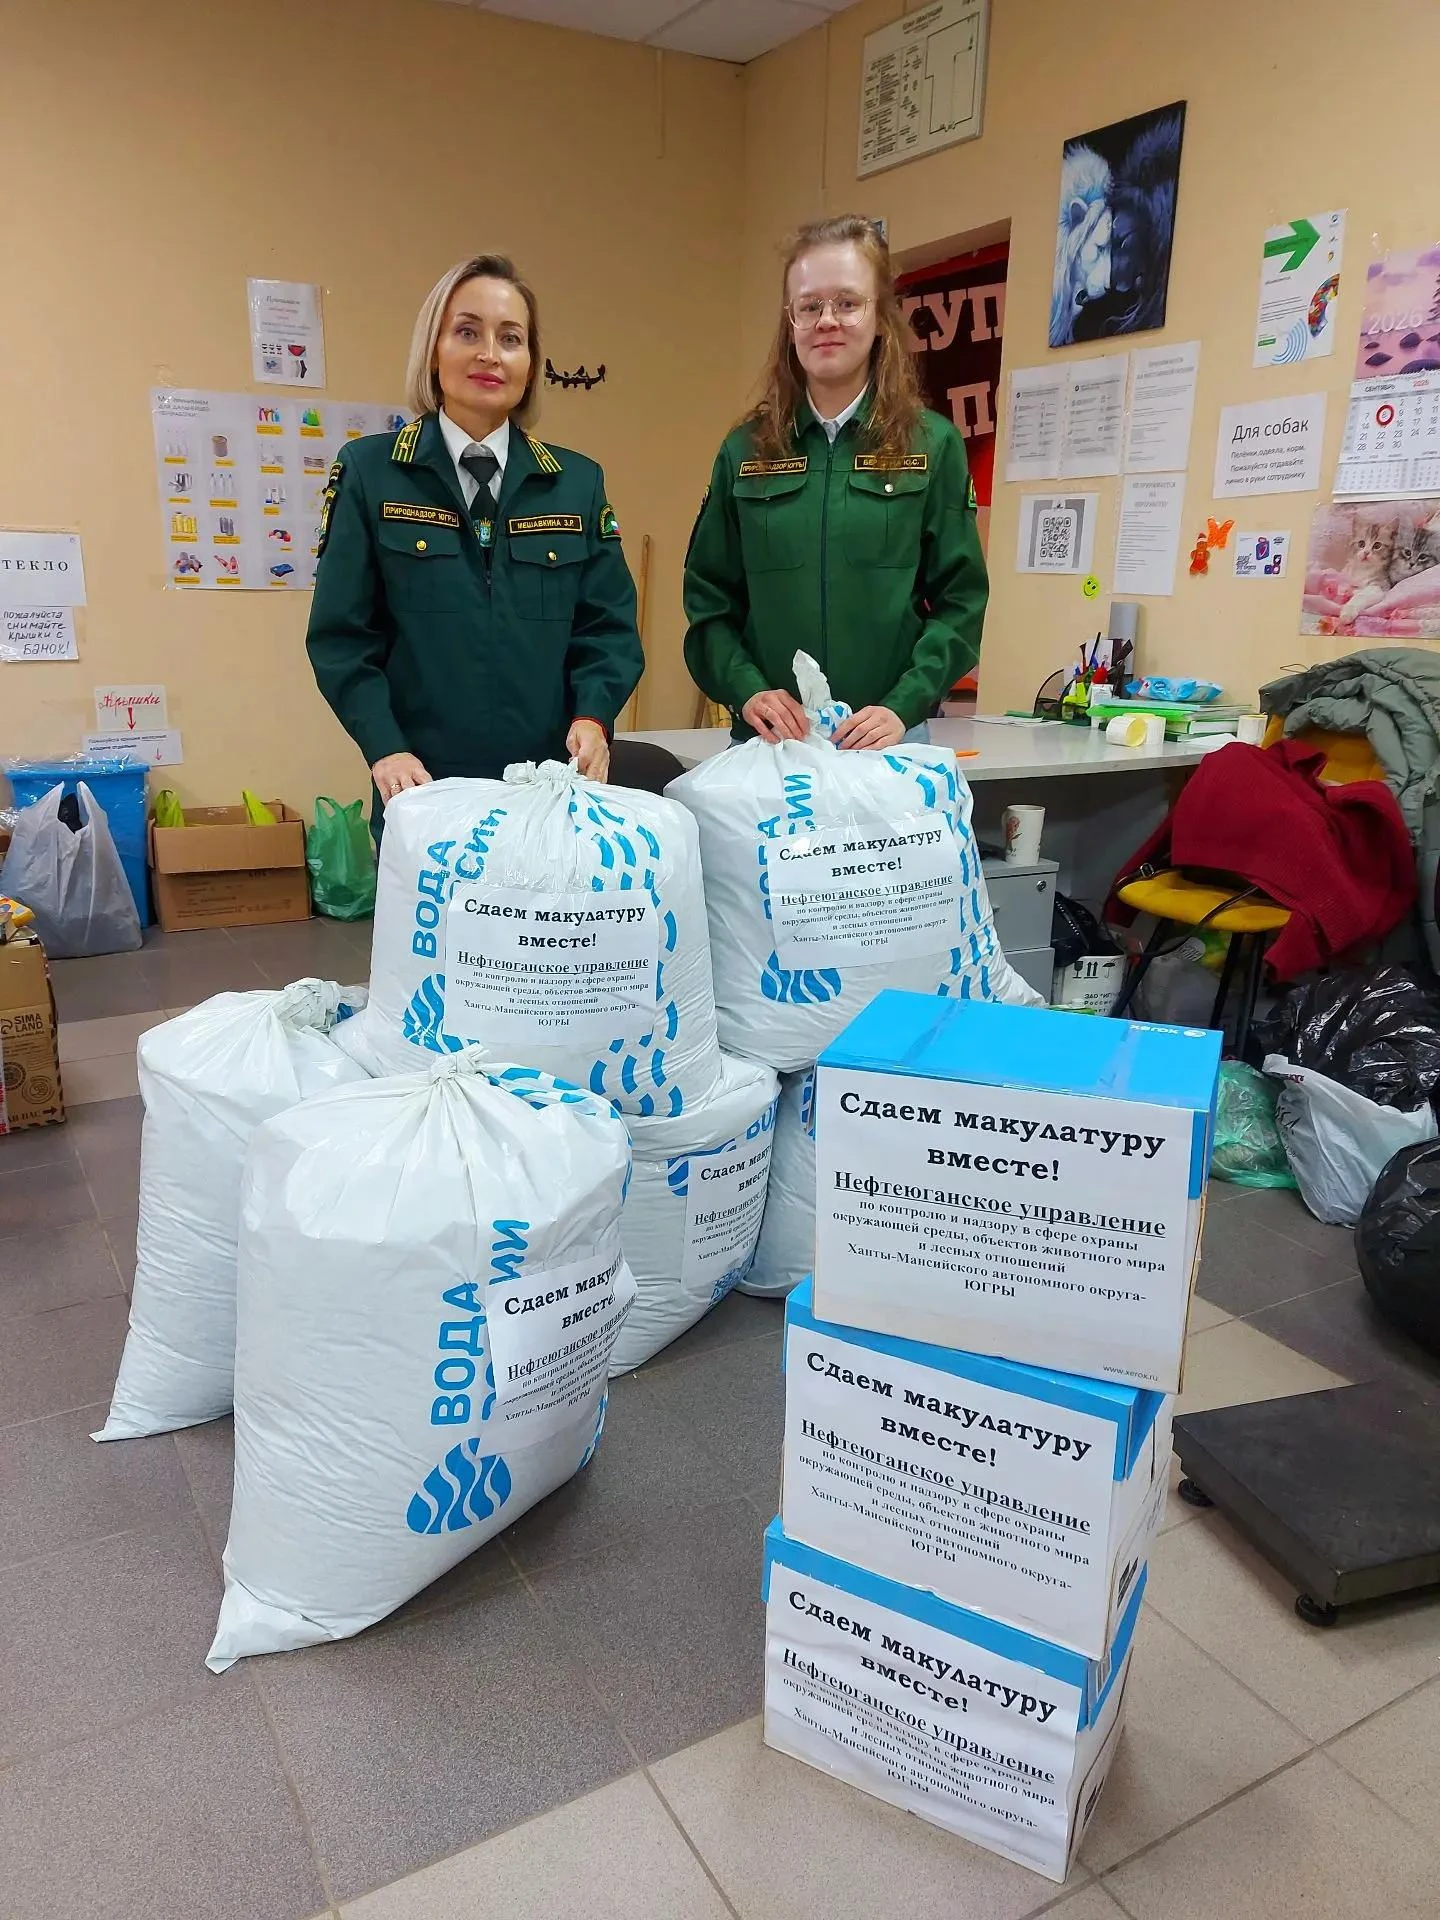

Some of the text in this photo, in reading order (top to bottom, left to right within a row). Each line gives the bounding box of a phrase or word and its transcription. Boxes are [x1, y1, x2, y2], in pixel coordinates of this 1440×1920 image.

[1231, 417, 1309, 444] Для собак
[1376, 431, 1386, 440] 22
[1393, 430, 1403, 438] 23
[1410, 428, 1420, 437] 24
[1230, 462, 1268, 473] Пожалуйста
[385, 506, 458, 523] ПРИРОДНАДЗОР ЮГРЫ
[517, 519, 562, 530] МЕШАВКИНА
[2, 559, 69, 572] ТЕКЛО
[843, 828, 942, 853] макулатуру
[832, 857, 902, 878] вместе!
[412, 840, 456, 958] ВОДА
[781, 876, 953, 906] Нефтеюганское управление
[464, 898, 646, 926] Сдаем макулатуру
[518, 933, 597, 948] вместе!
[860, 937, 888, 946] ЮГРЫ
[457, 950, 648, 975] Нефтеюганское управление
[14, 1013, 42, 1025] SIMA
[15, 1022, 44, 1033] LAND
[538, 1018, 569, 1026] ЮГРЫ
[1129, 1024, 1180, 1034] xerox
[840, 1092, 1166, 1158] Сдаем макулатуру
[700, 1160, 746, 1181] Сдаем
[927, 1148, 1060, 1182] вместе!
[834, 1171, 1166, 1237] Нефтеюганское управление
[859, 1200, 1138, 1251] по контролю и надзору в сфере охраны
[832, 1212, 1166, 1273] окружающей среды, объектов животного мира
[918, 1242, 1066, 1273] и лесных отношений
[848, 1242, 1148, 1301] Ханты-Мансийского автономного округа-
[504, 1284, 569, 1316] Сдаем
[964, 1278, 1016, 1298] ЮГРЫ
[430, 1282, 487, 1425] ВОДА
[507, 1330, 598, 1382] Нефтеюганское
[1102, 1364, 1159, 1382] www.xerox.ru
[806, 1352, 1092, 1461] Сдаем макулатуру
[880, 1416, 996, 1467] вместе!
[801, 1418, 1090, 1533] Нефтеюганское управление
[800, 1455, 1090, 1566] окружающей среды, объектов животного мира
[822, 1450, 1065, 1542] по контролю и надзору в сфере охраны
[810, 1486, 1072, 1589] Ханты-Мансийского автономного округа-
[872, 1498, 1000, 1550] и лесных отношений
[911, 1538, 956, 1562] ЮГРЫ
[788, 1590, 1058, 1723] Сдаем макулатуру
[860, 1656, 968, 1712] вместе!
[783, 1648, 1055, 1783] Нефтеюганское управление
[783, 1678, 1055, 1806] окружающей животного мира
[794, 1707, 1038, 1828] Ханты-Мансийского автономного округа-
[860, 1731, 902, 1756] лесных
[905, 1752, 970, 1791] отношений
[944, 1750, 980, 1768] сфере
[888, 1768, 929, 1793] ЮГРЫ
